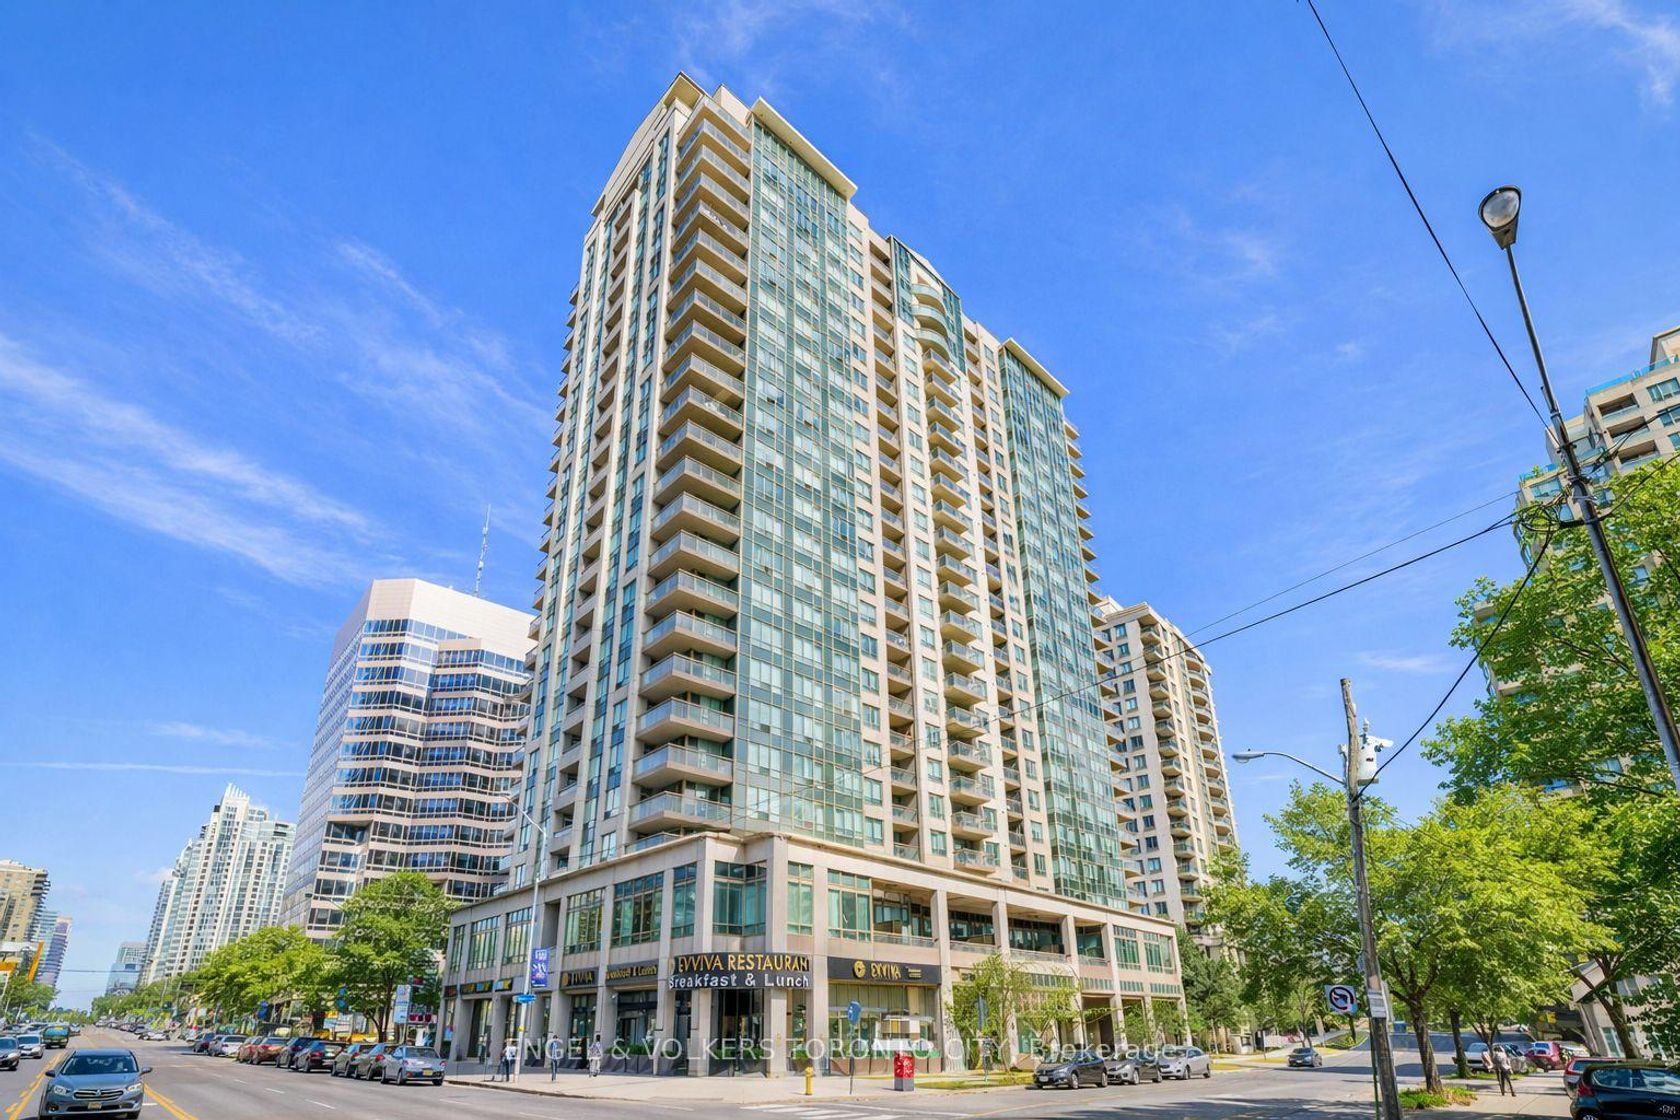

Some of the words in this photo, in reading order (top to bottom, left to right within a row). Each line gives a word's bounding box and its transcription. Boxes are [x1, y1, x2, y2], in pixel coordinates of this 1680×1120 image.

[669, 973, 737, 989] Breakfast
[744, 974, 756, 987] &
[764, 973, 809, 988] Lunch
